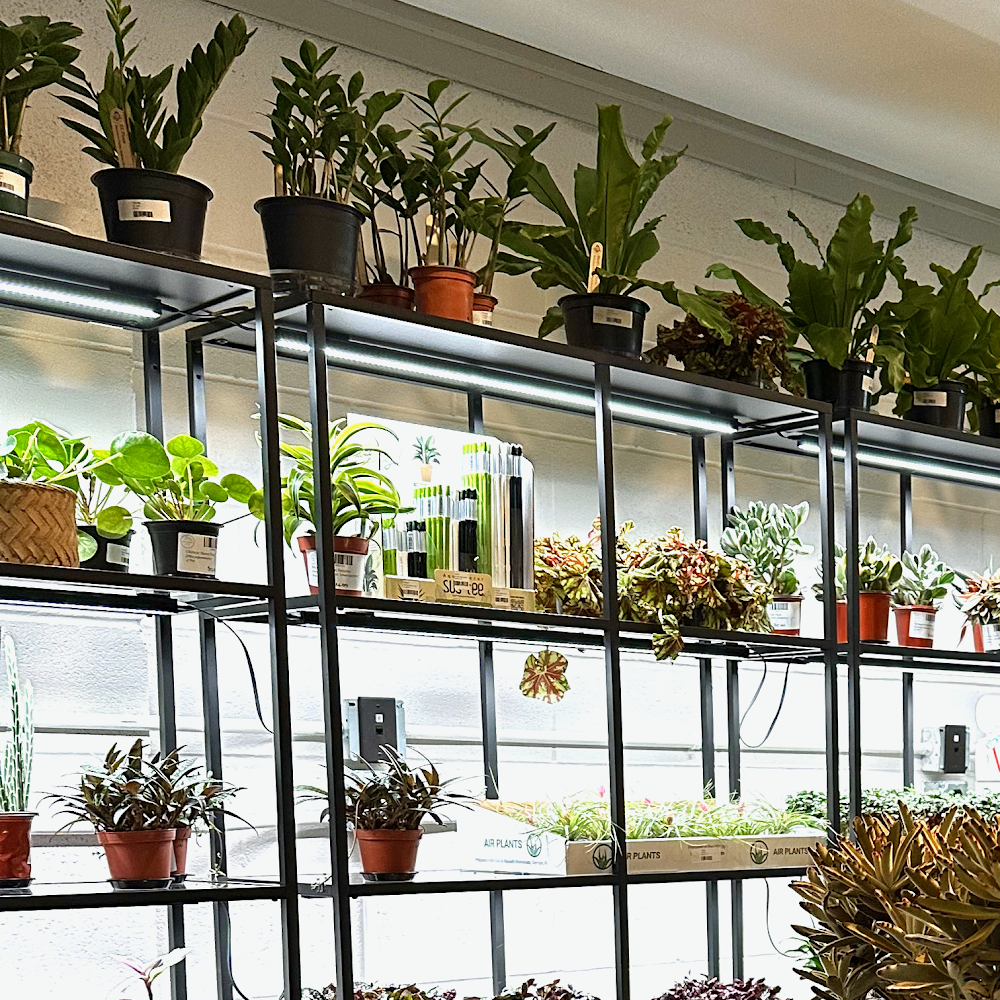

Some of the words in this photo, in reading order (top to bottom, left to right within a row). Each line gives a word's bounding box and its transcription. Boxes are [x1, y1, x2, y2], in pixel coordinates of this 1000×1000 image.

[484, 838, 495, 848] AIR
[496, 839, 523, 849] PLANTS
[633, 851, 661, 860] PLANTS
[773, 848, 784, 856] AIR
[785, 847, 809, 855] PLANTS
